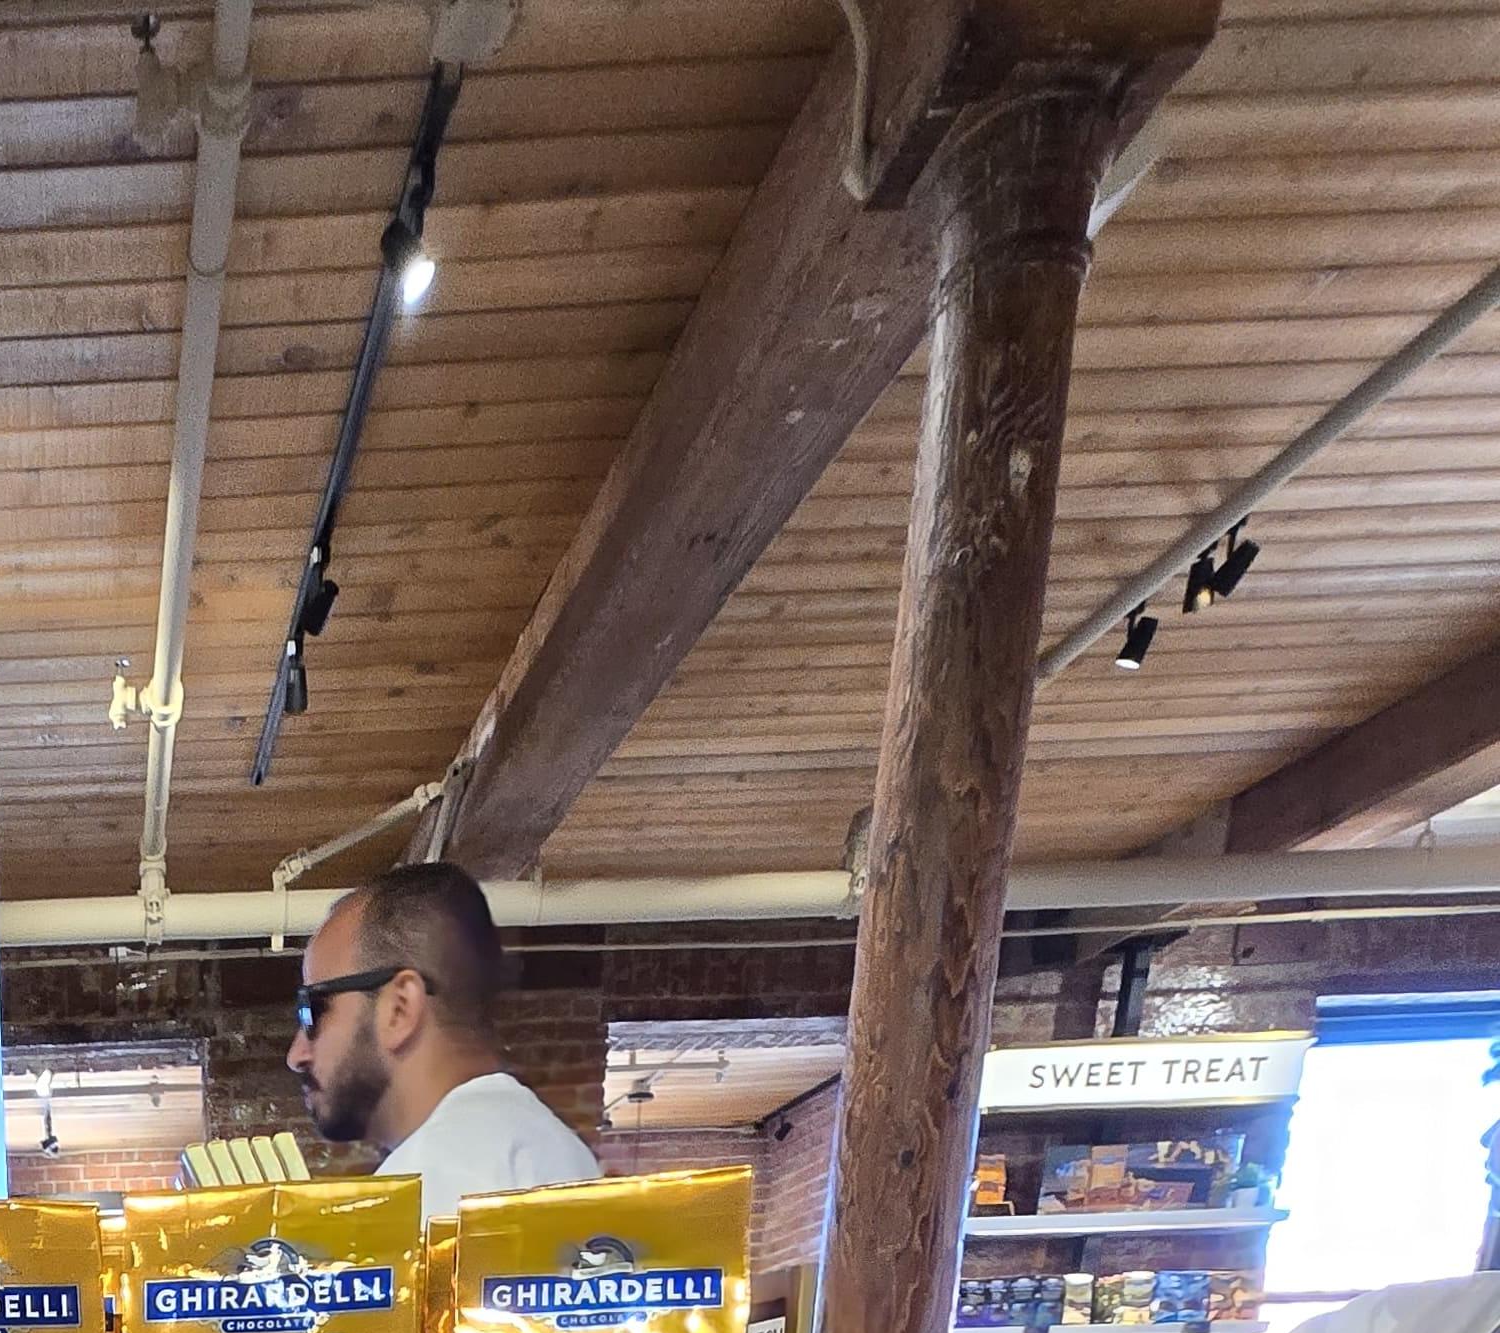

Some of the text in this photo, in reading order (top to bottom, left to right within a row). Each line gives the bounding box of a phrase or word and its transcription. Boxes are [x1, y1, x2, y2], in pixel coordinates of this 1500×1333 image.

[1029, 1056, 1269, 1088] SWEET TREAT
[155, 1277, 385, 1312] GHIRARDELLI
[492, 1276, 711, 1307] GHIRARDELLI
